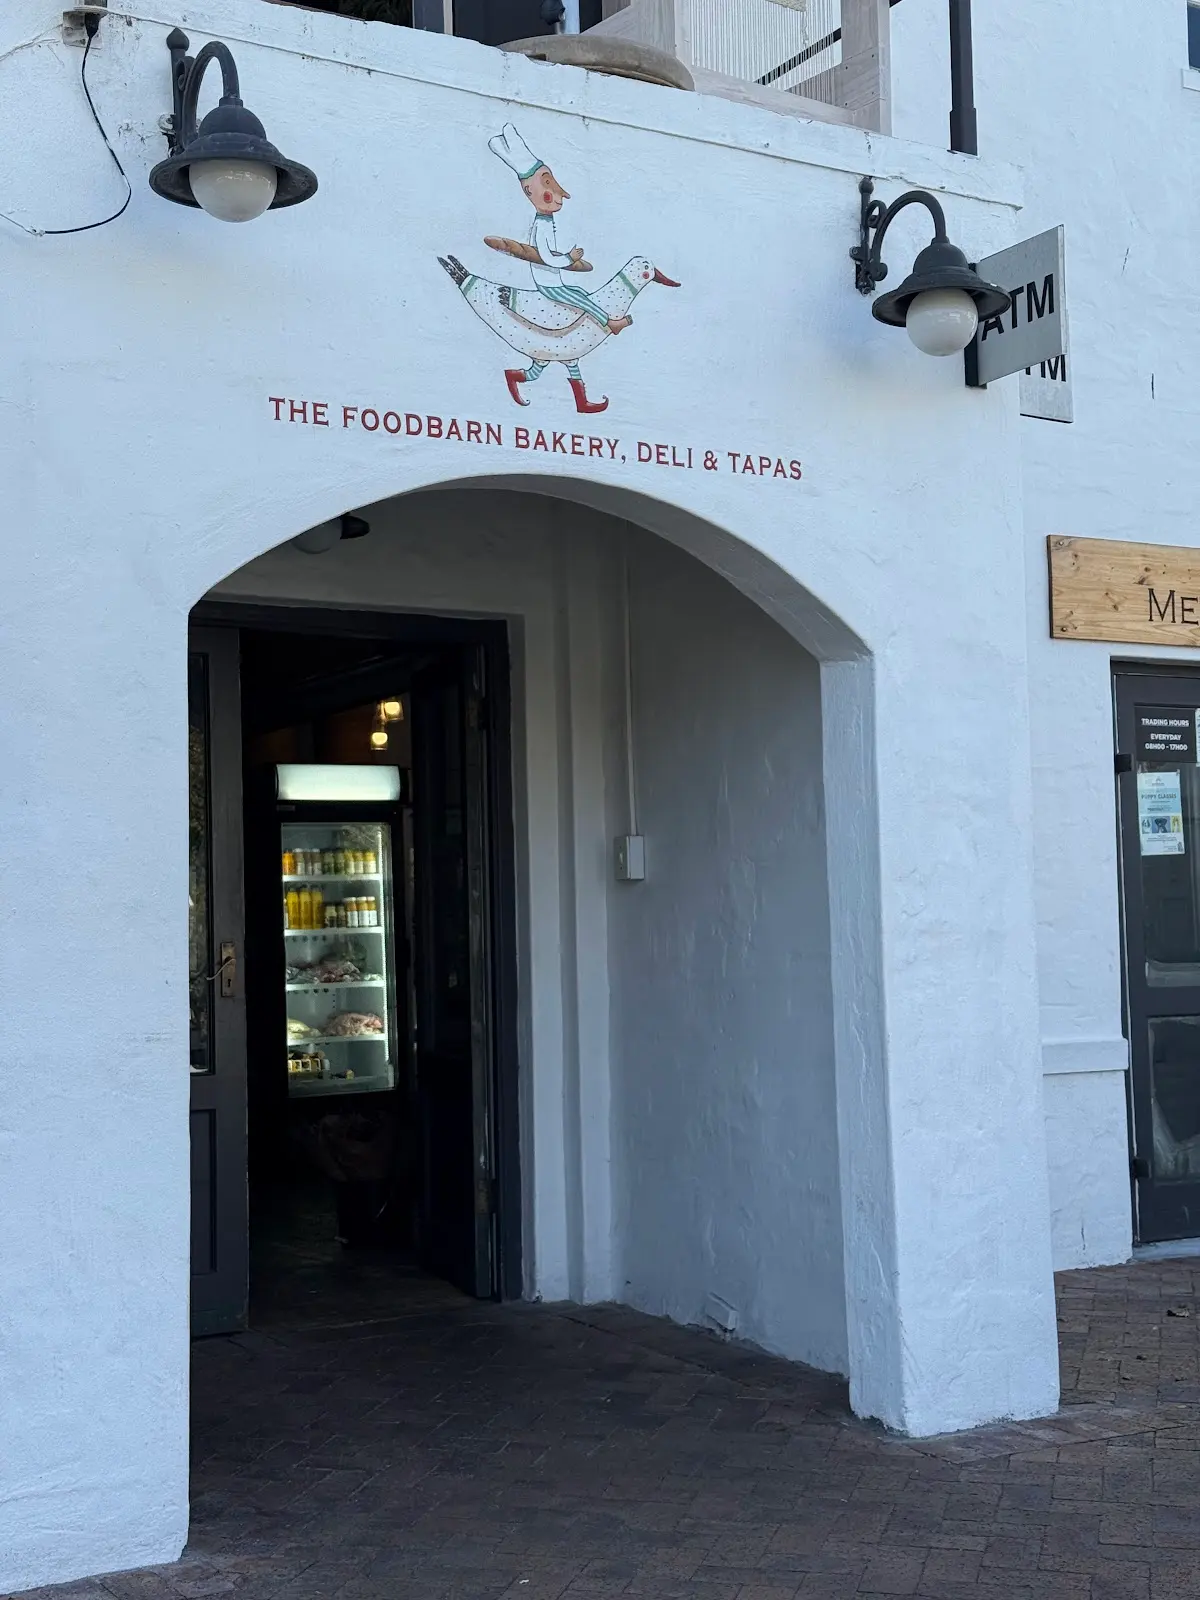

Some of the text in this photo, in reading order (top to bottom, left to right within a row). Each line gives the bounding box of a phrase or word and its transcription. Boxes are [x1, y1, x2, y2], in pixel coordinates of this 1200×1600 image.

[269, 397, 802, 480] THE FOODBARN BAKERY, DELI & TAPAS
[1141, 718, 1189, 727] TRADING HOURS
